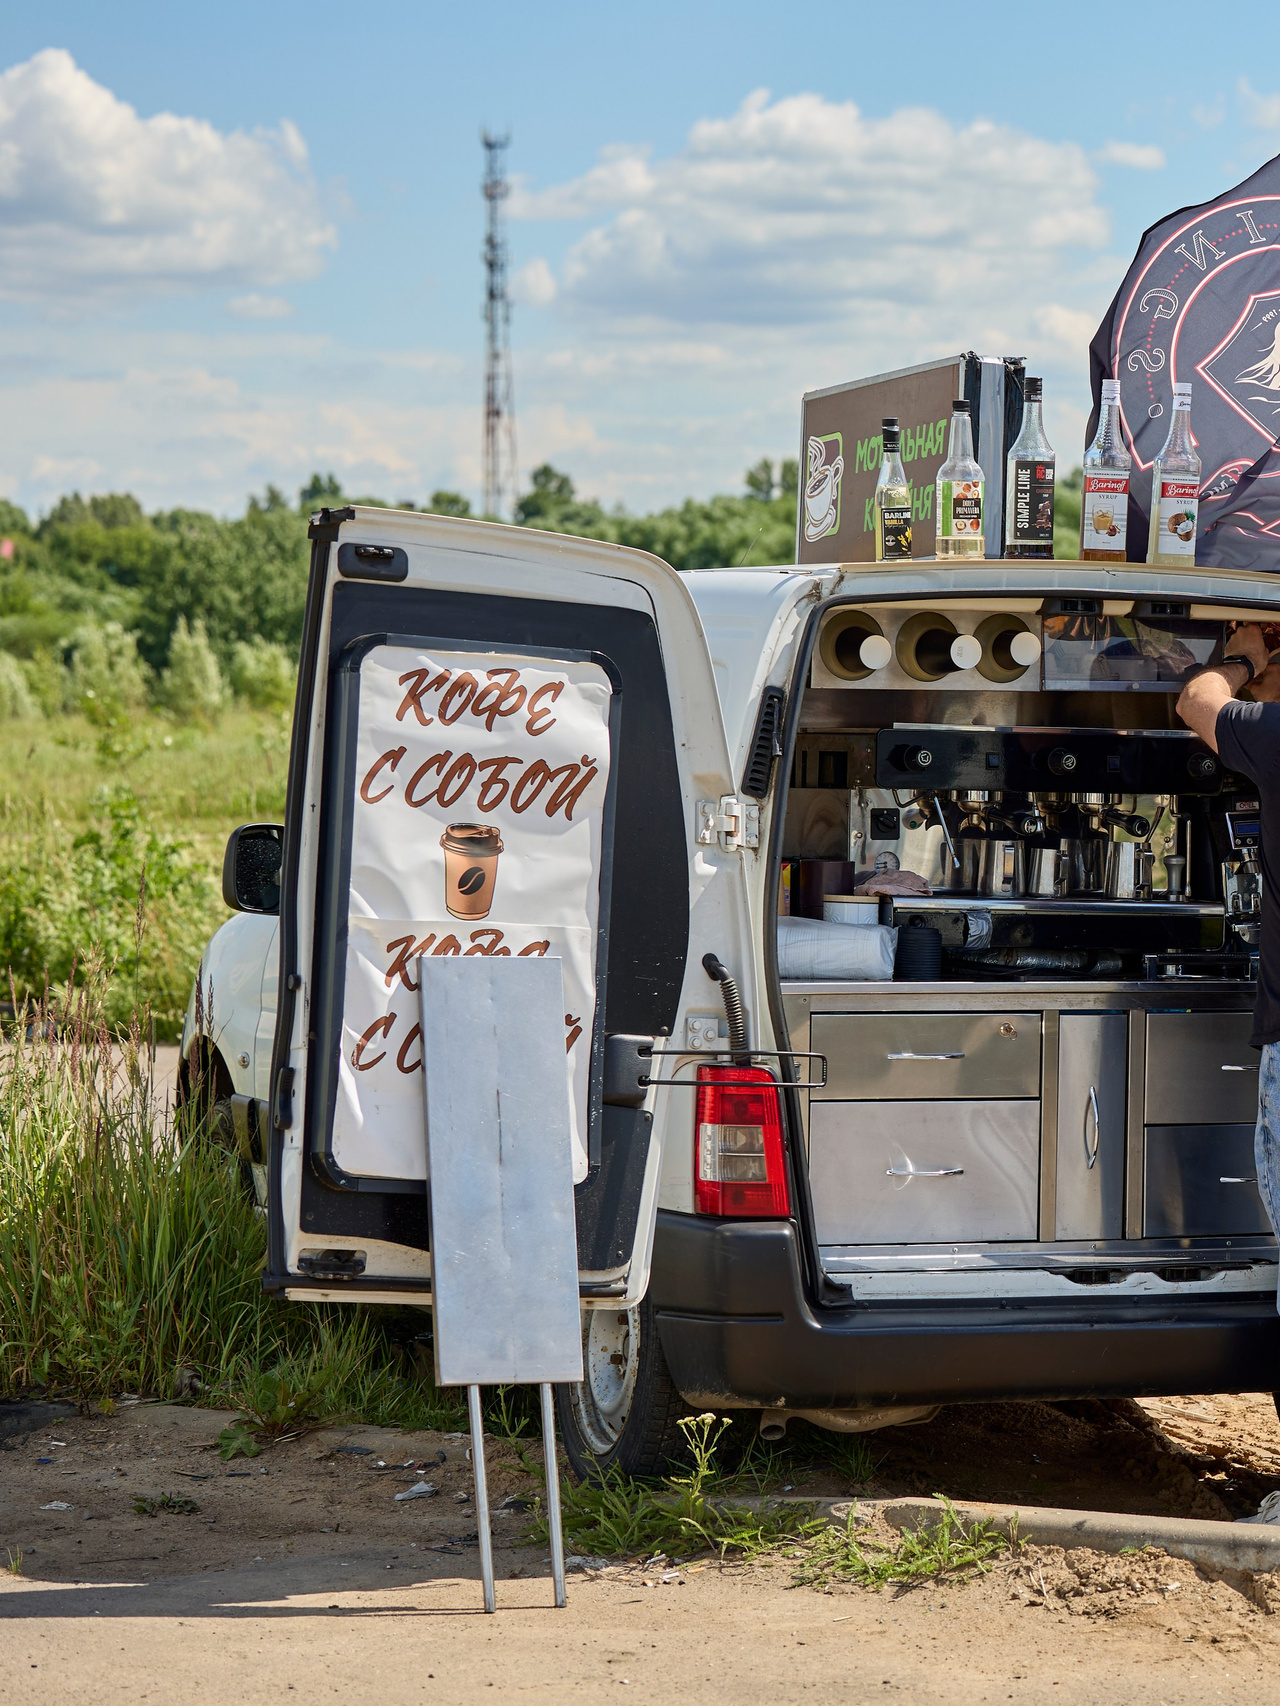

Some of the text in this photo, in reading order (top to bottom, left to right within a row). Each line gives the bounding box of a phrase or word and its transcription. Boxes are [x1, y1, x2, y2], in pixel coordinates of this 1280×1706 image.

[1017, 468, 1031, 529] SIMPLE LINE
[395, 668, 565, 737] КОФЕ
[360, 745, 599, 821] С СОБОЙ
